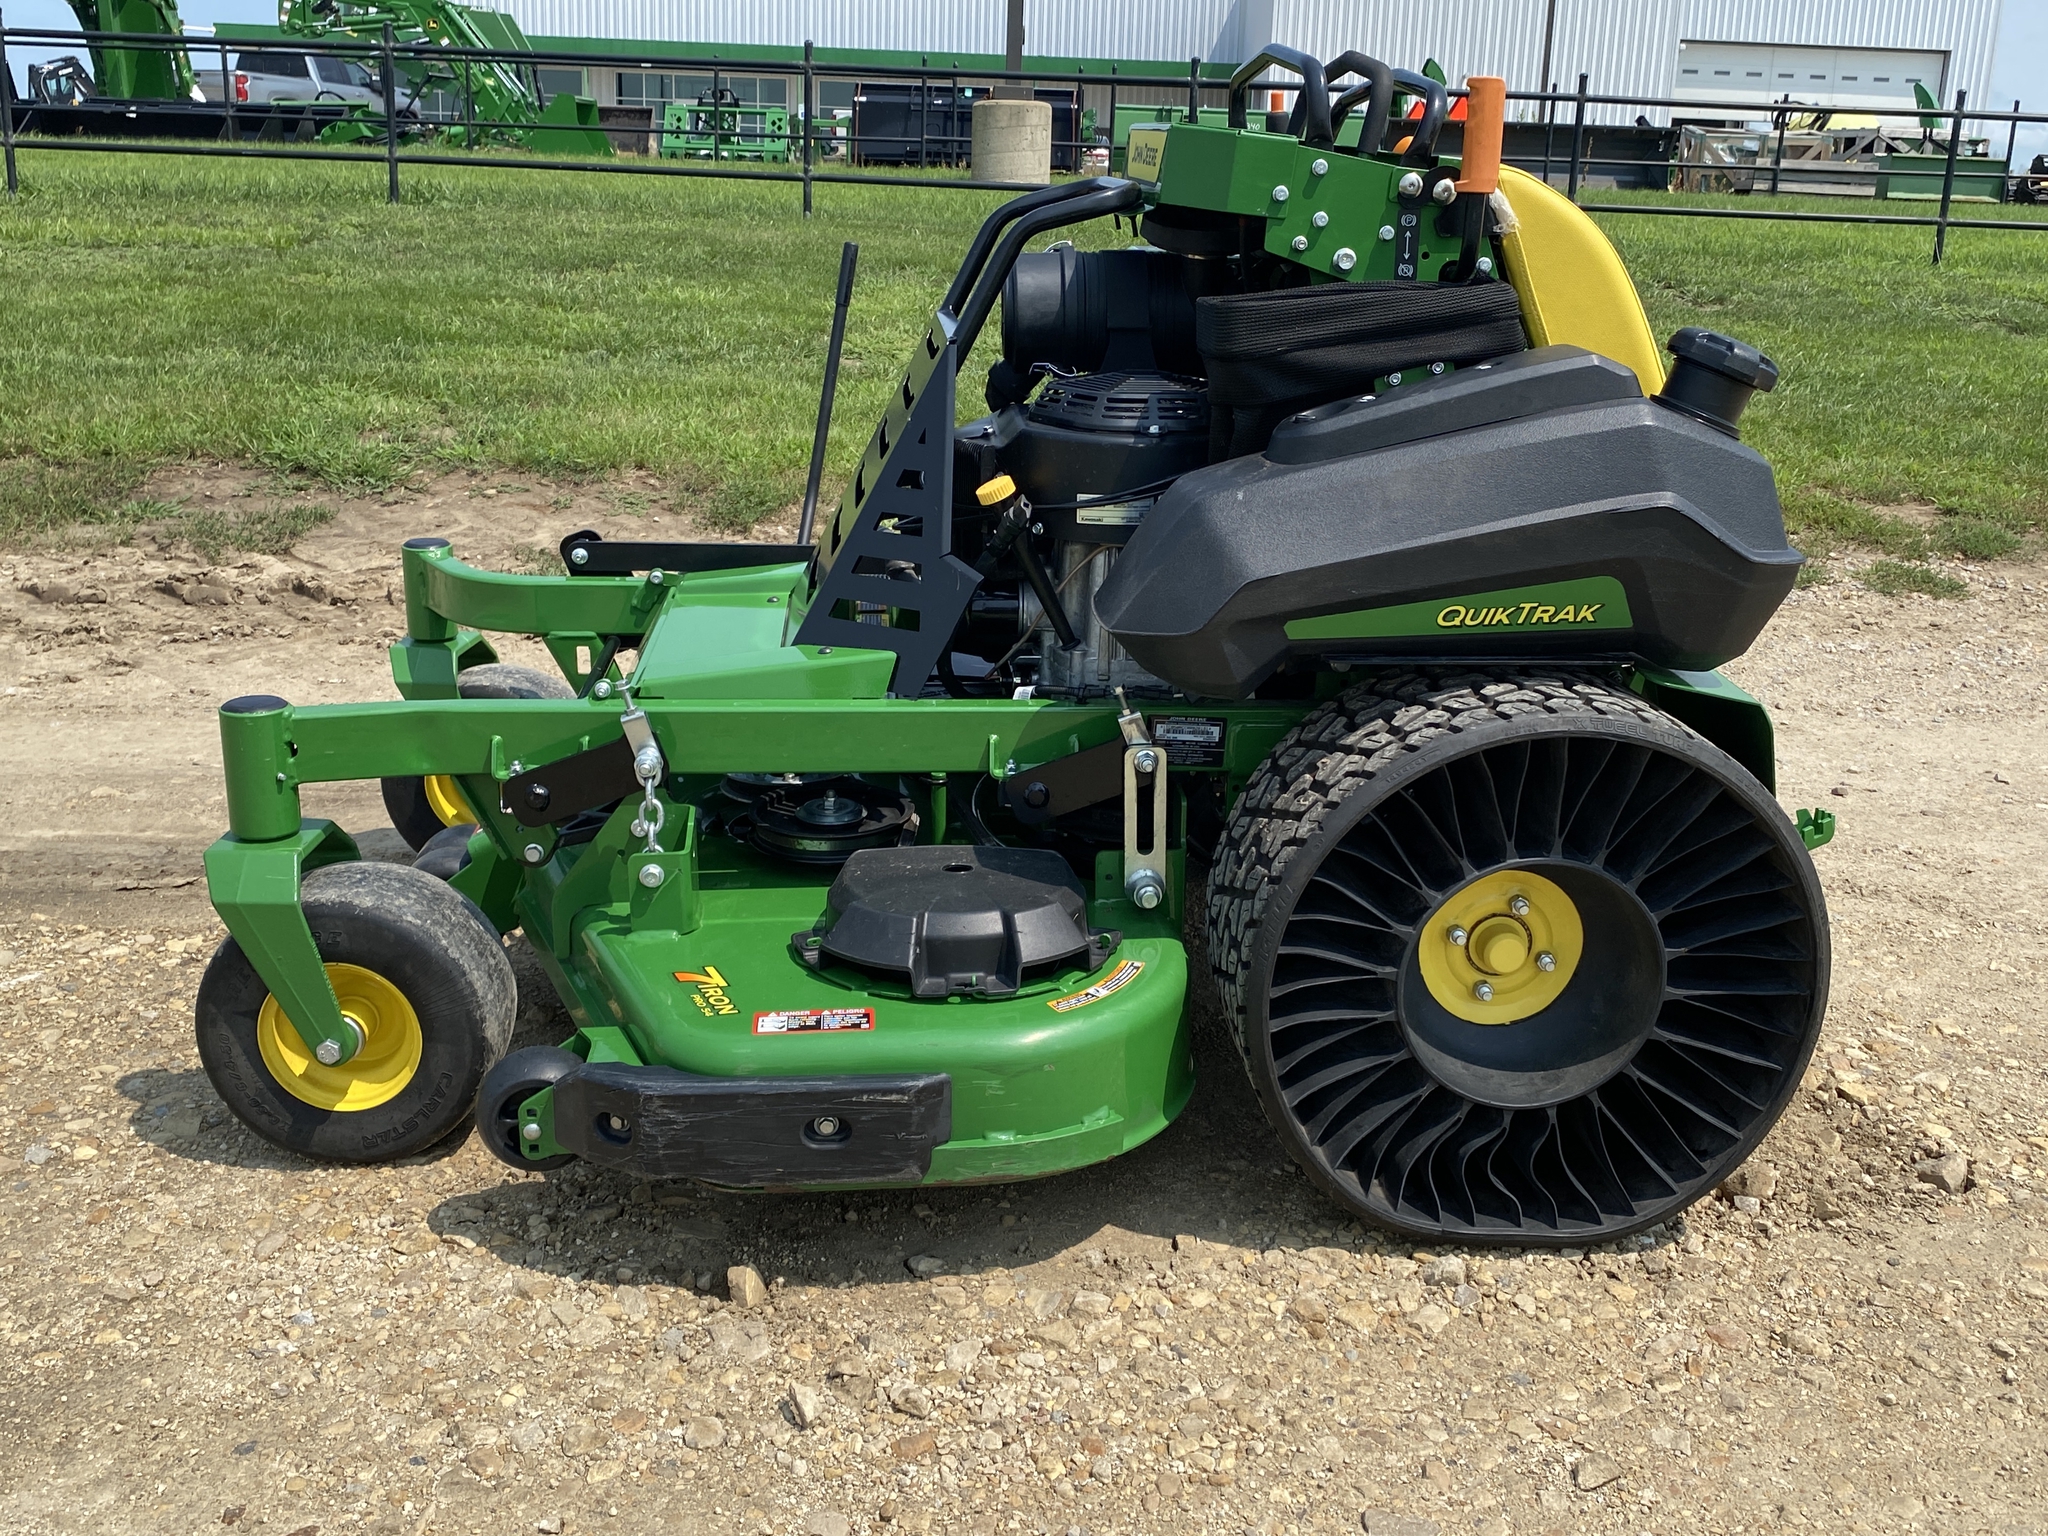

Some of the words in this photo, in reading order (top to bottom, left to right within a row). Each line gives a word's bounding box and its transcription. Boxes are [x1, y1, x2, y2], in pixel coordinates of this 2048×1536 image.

[1131, 142, 1144, 164] JOHN
[1142, 142, 1159, 167] DEERE
[1436, 602, 1606, 628] QUIKTRAK
[1589, 718, 1648, 739] TWEEL
[690, 994, 707, 1008] PRO
[361, 1071, 454, 1149] CARLSTAR
